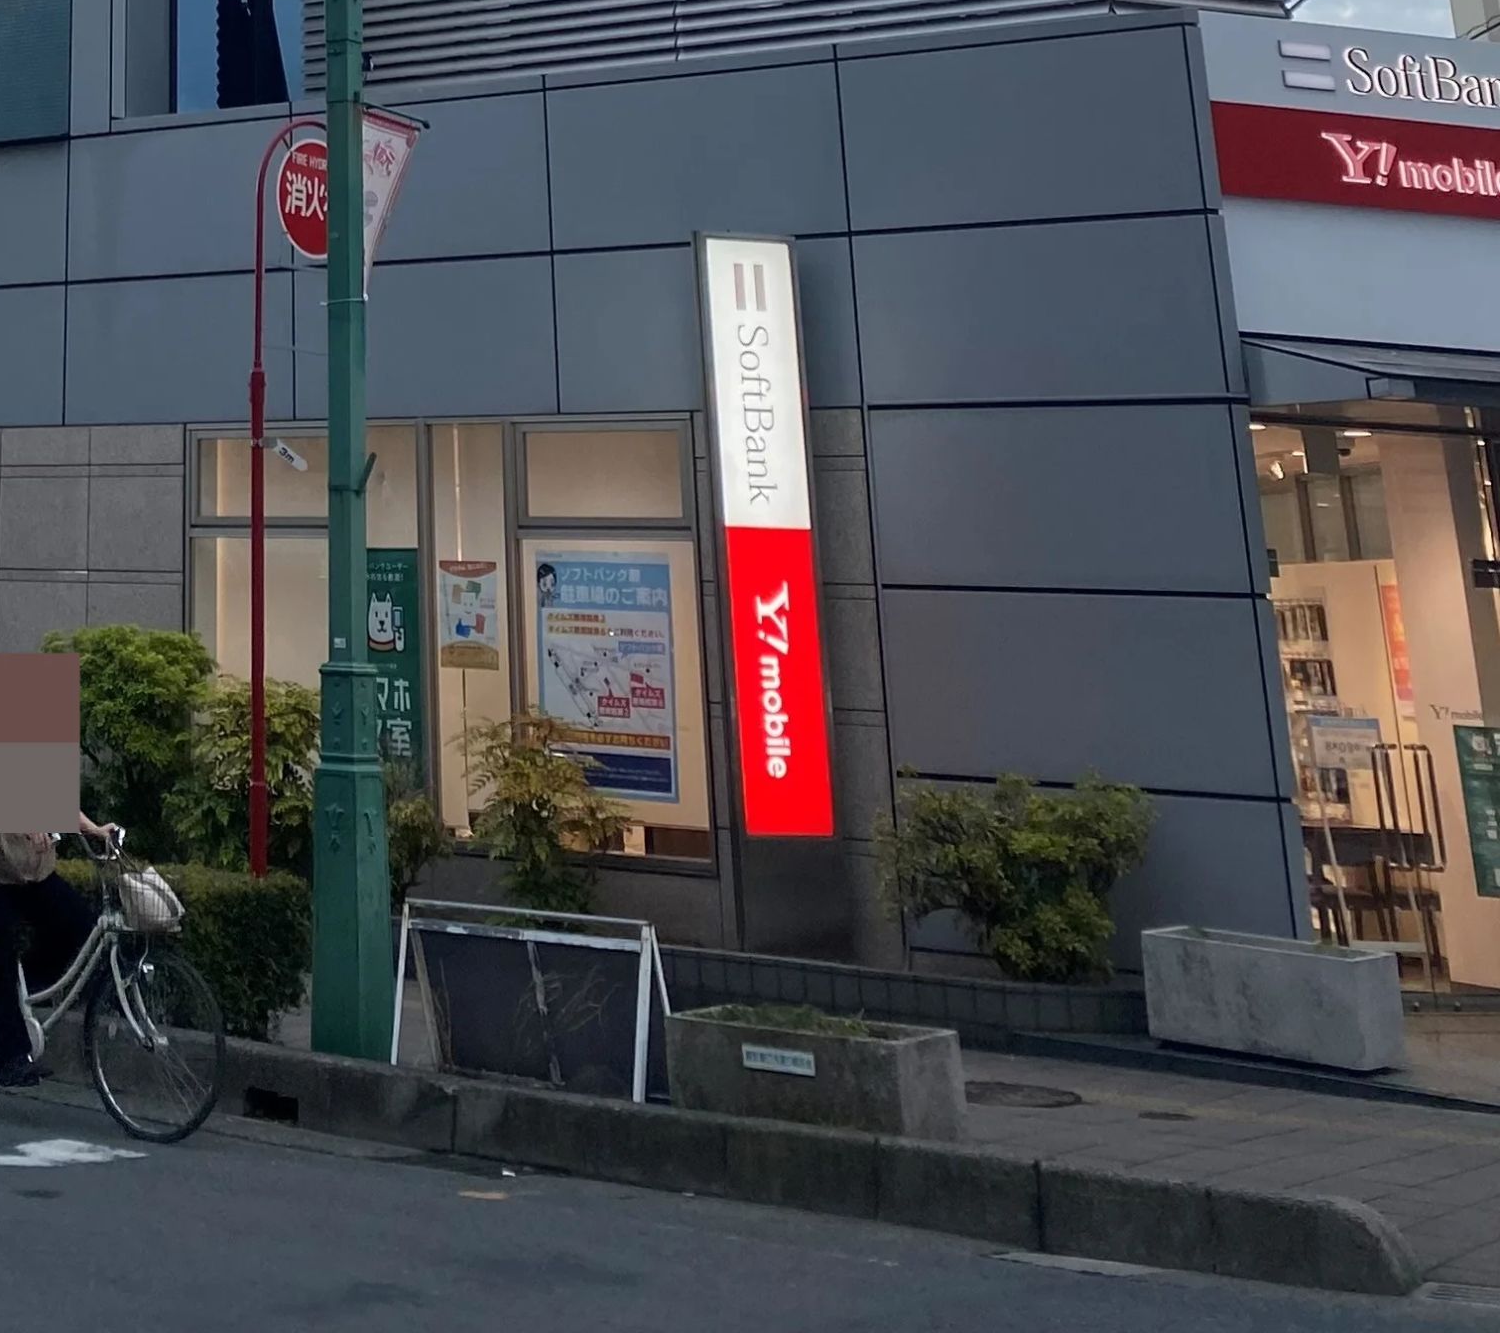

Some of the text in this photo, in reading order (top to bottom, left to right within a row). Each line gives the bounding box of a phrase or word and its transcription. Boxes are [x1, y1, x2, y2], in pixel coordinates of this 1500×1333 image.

[1342, 45, 1500, 109] SoftBan
[291, 151, 328, 170] FIRE HYDR
[1321, 131, 1500, 197] Y!mobil
[285, 170, 328, 221] 消火
[736, 323, 779, 504] SoftBank
[376, 677, 411, 713] マホ
